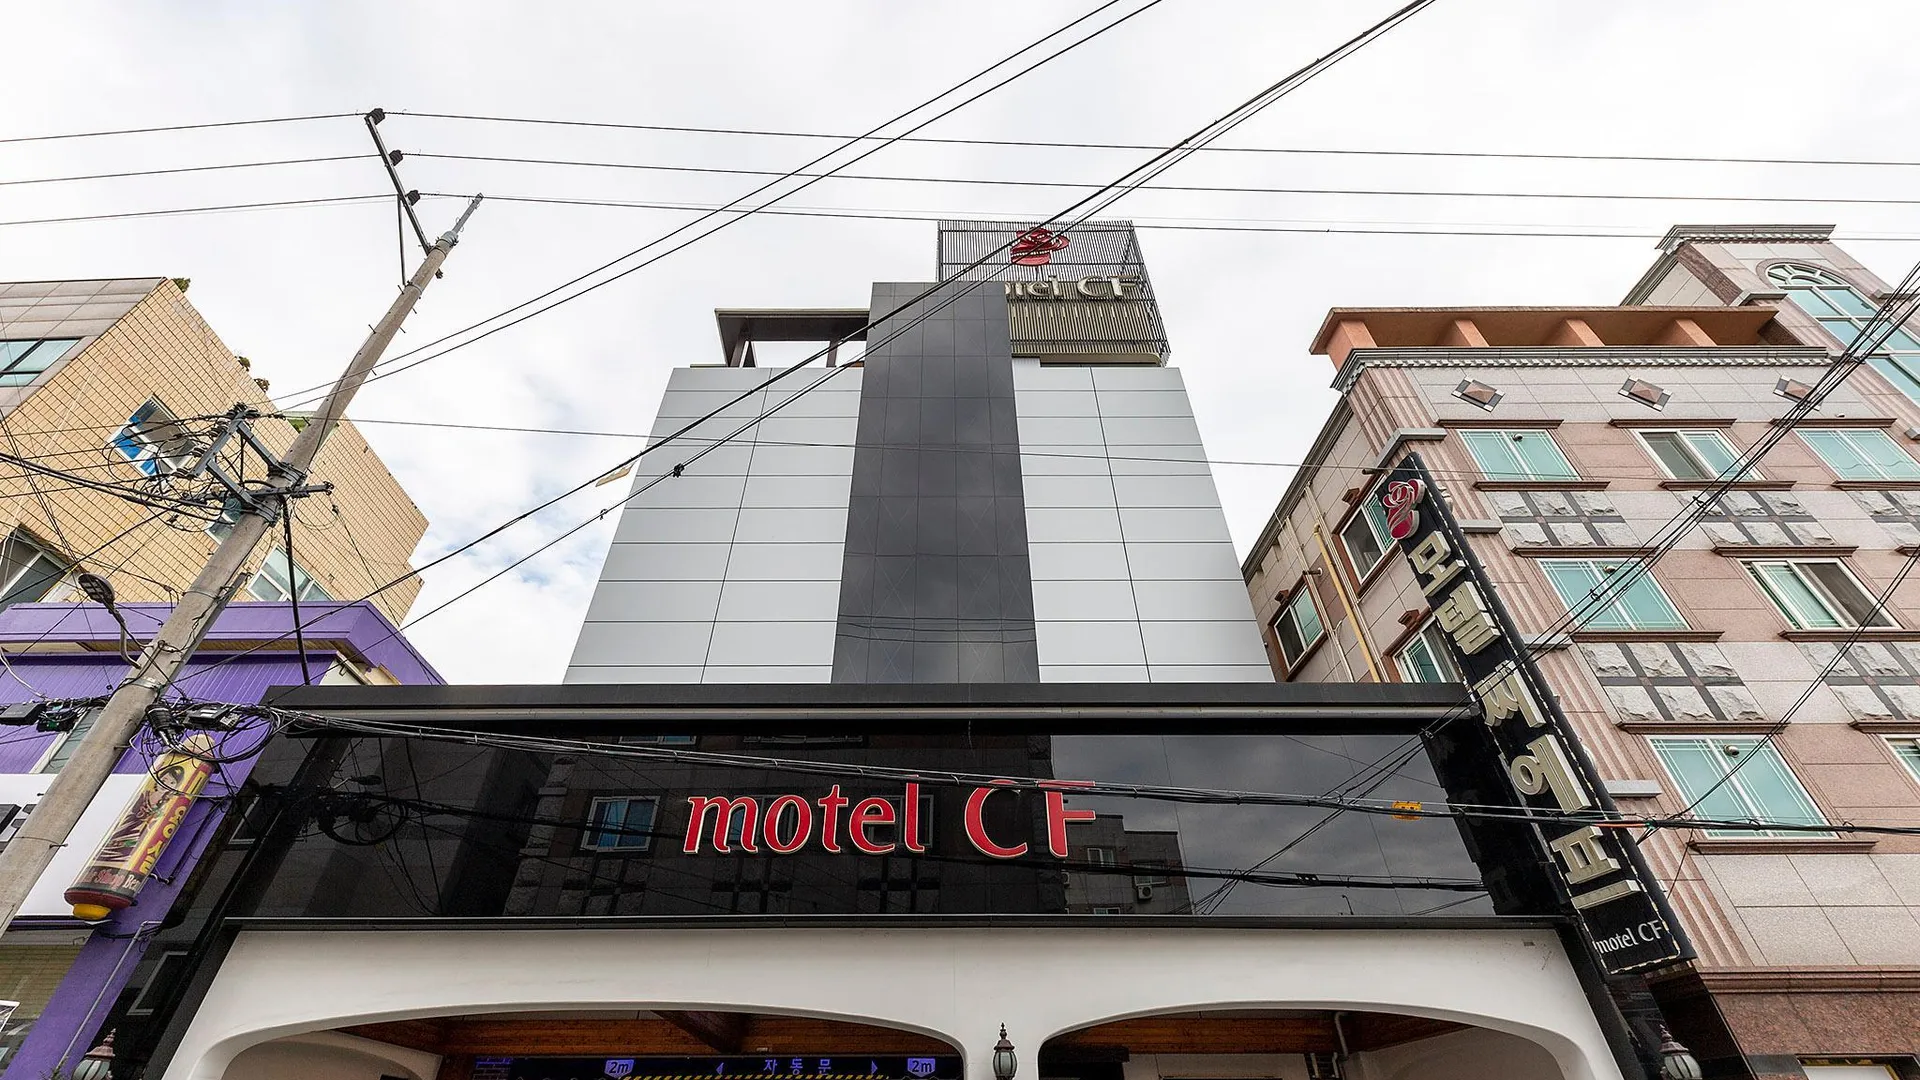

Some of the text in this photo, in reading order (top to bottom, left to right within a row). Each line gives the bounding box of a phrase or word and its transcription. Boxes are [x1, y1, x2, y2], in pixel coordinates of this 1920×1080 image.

[1077, 275, 1140, 299] CF
[683, 775, 1097, 859] motel CF
[1595, 919, 1662, 954] motel CF
[608, 1061, 630, 1074] 2m
[911, 1059, 933, 1073] 2m
